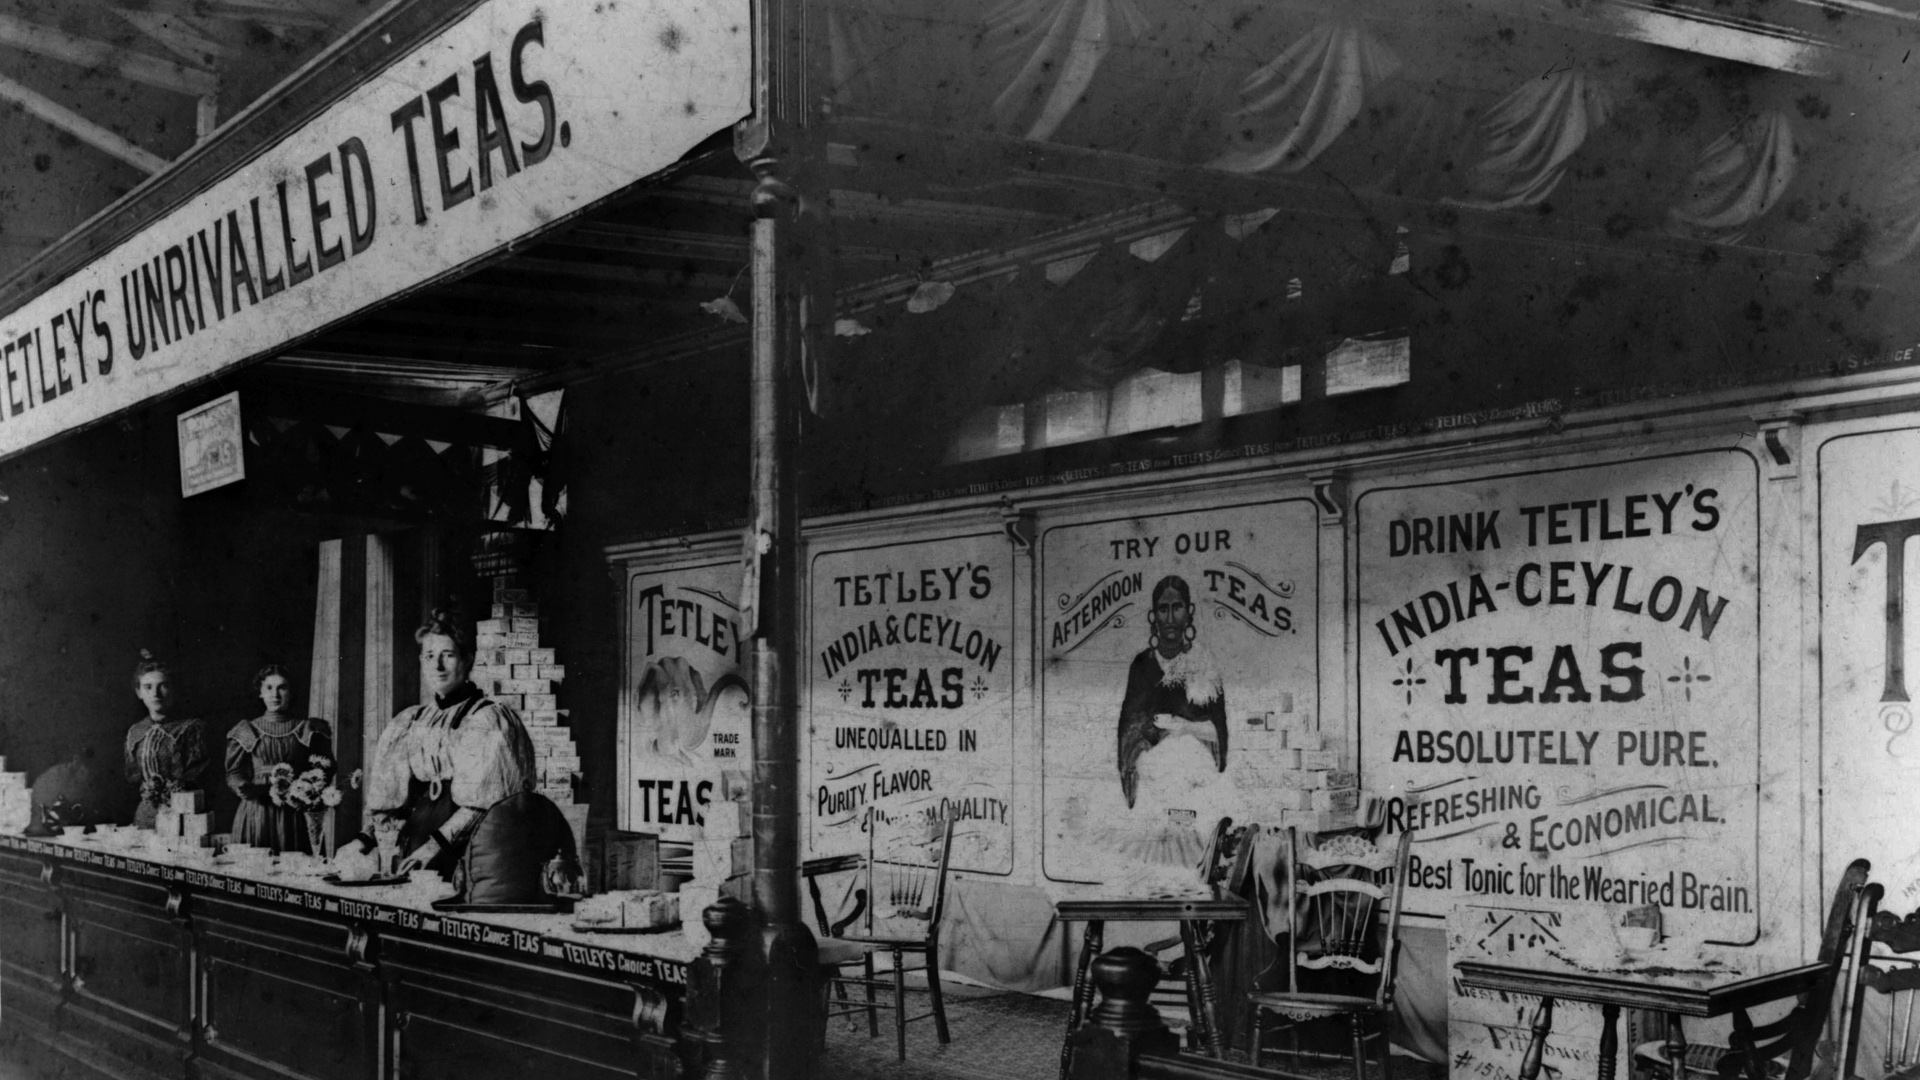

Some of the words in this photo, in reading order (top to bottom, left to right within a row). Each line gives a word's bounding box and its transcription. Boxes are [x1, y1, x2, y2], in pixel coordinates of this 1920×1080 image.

[0, 288, 114, 422] ETLEY'S
[120, 135, 377, 361] UNRIVALLED
[389, 21, 571, 226] TEAS.
[969, 480, 1000, 494] TETLEY'S
[1127, 460, 1151, 473] TEAS
[1172, 451, 1213, 467] TETLEY'S
[1244, 443, 1271, 457] TEAS
[1295, 432, 1341, 450] TETLEY'S
[1376, 423, 1407, 439] TEAS
[1435, 410, 1488, 429] TETLEY'S
[1526, 398, 1562, 417] TEAS
[1110, 538, 1158, 561] TRY
[1174, 529, 1231, 554] OUR
[1389, 510, 1500, 557] DRINK
[1520, 483, 1720, 547] TETLEY'S
[834, 563, 991, 607] TETLEY'S
[1052, 572, 1143, 649] AFTERNOON
[1203, 569, 1297, 635] TEAS.
[1375, 561, 1730, 656] INDIA-CEYLON
[857, 668, 965, 710] TEAS
[1435, 641, 1646, 704] TEAS
[713, 733, 739, 745] TRADE
[713, 749, 736, 759] MARK
[835, 727, 946, 752] UNEQUALLED
[959, 730, 976, 751] IN
[1392, 730, 1600, 765] ABSOLUTELY
[1617, 731, 1719, 767] PURE.
[638, 779, 713, 826] TEAS
[873, 770, 932, 800] FLAVOR
[1386, 784, 1542, 835] REFRESHING
[1501, 822, 1521, 850] &
[1528, 794, 1727, 852] ECONOMICAL.
[1408, 854, 1453, 890] Best
[1461, 858, 1515, 894] Tonic
[1518, 862, 1545, 897] for
[1549, 868, 1581, 900] the
[1582, 863, 1674, 907] Wearied
[1681, 871, 1754, 914] Brain.
[73, 847, 91, 864] TETLEY'S
[104, 855, 116, 868] TEAS
[126, 858, 145, 875] TETLEY'S
[161, 865, 174, 881] TEAS
[185, 869, 209, 888] TETLEY'S
[226, 877, 242, 895] TEAS
[256, 883, 284, 903] TETLEY'S
[303, 891, 322, 910] TEAS
[339, 899, 373, 920] TETLEY'S
[373, 905, 397, 925] CHOICE
[397, 908, 419, 930] TEAS
[441, 917, 481, 943] TETLEY'S
[482, 925, 511, 947] CHOICE
[512, 930, 540, 954] TEAS
[542, 942, 564, 959] DRINK
[563, 942, 616, 971] TETLEY'S
[617, 953, 653, 977] CHOICE
[654, 959, 688, 984] TEAS
